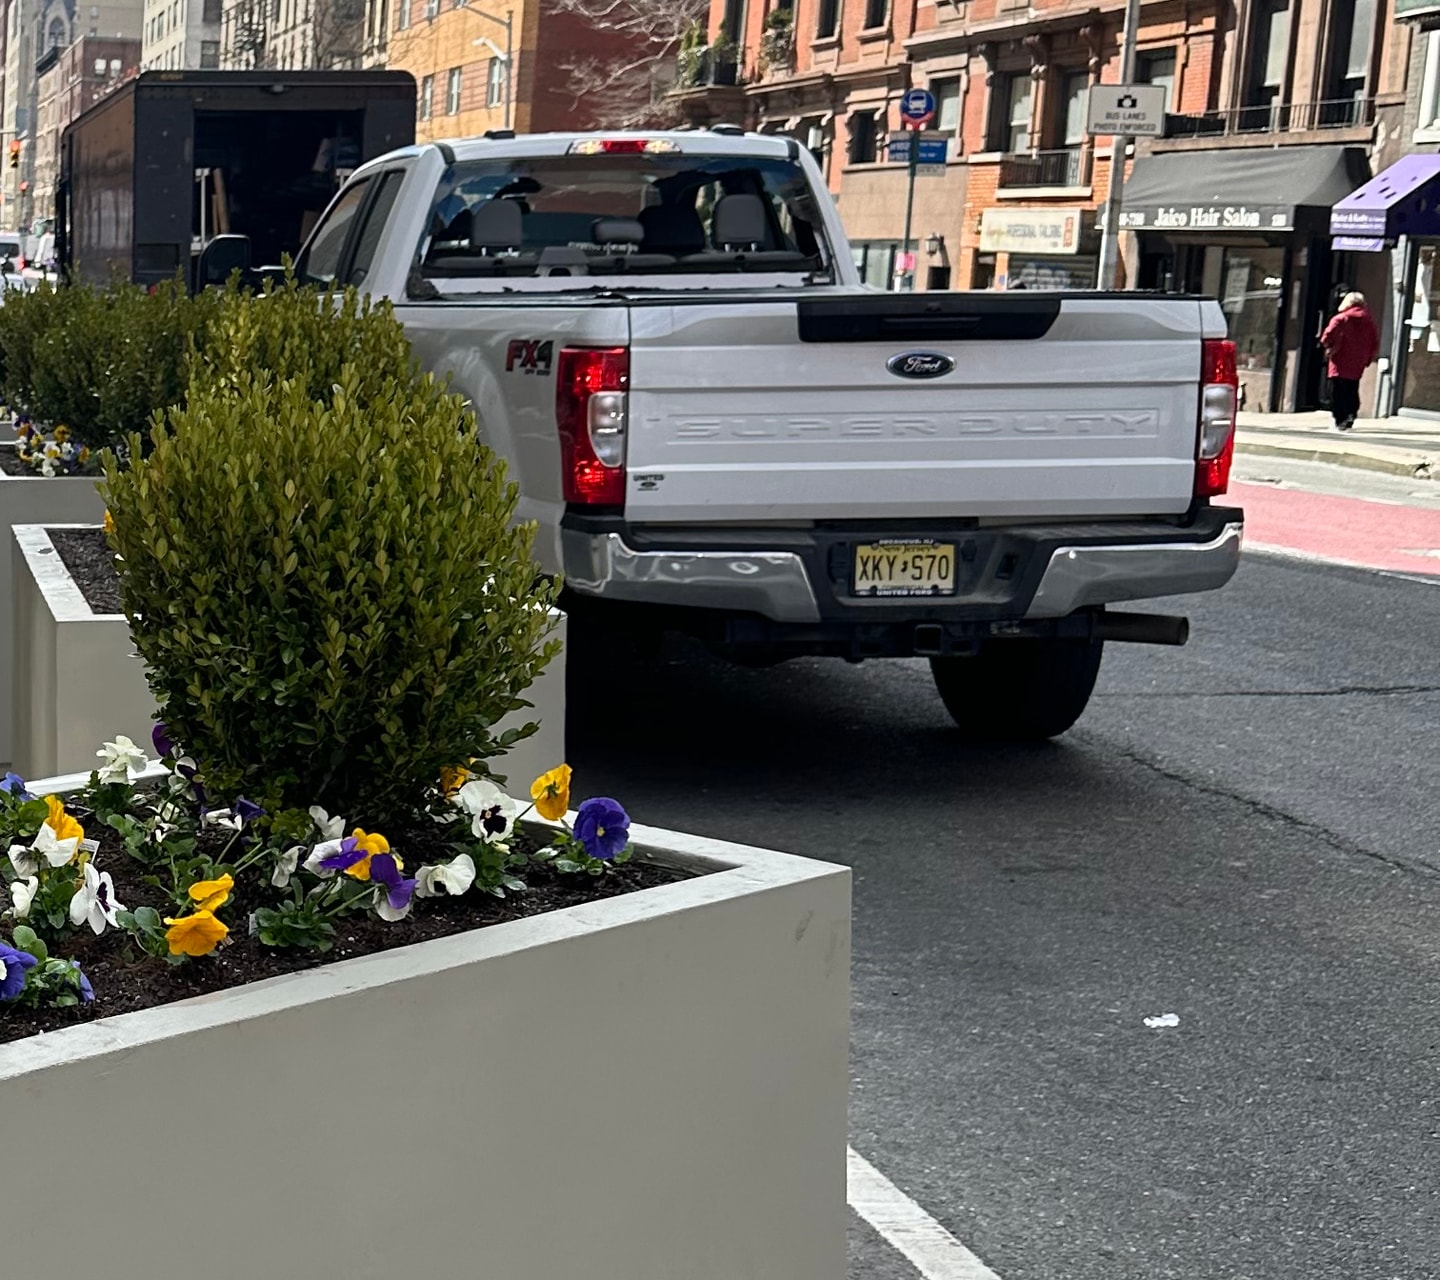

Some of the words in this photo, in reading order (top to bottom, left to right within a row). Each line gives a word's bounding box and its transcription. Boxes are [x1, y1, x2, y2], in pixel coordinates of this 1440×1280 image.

[1105, 111, 1120, 120] BUS
[1122, 111, 1146, 121] LANES
[1093, 122, 1117, 131] PHOTO
[1119, 122, 1157, 132] ENFORCED
[1153, 207, 1187, 227] Jaico
[1189, 207, 1221, 227] Hair
[1222, 206, 1260, 227] Salon
[505, 339, 554, 372] FX4
[903, 355, 943, 376] Ford
[676, 417, 938, 438] SUPER
[960, 413, 1153, 437] DUTY
